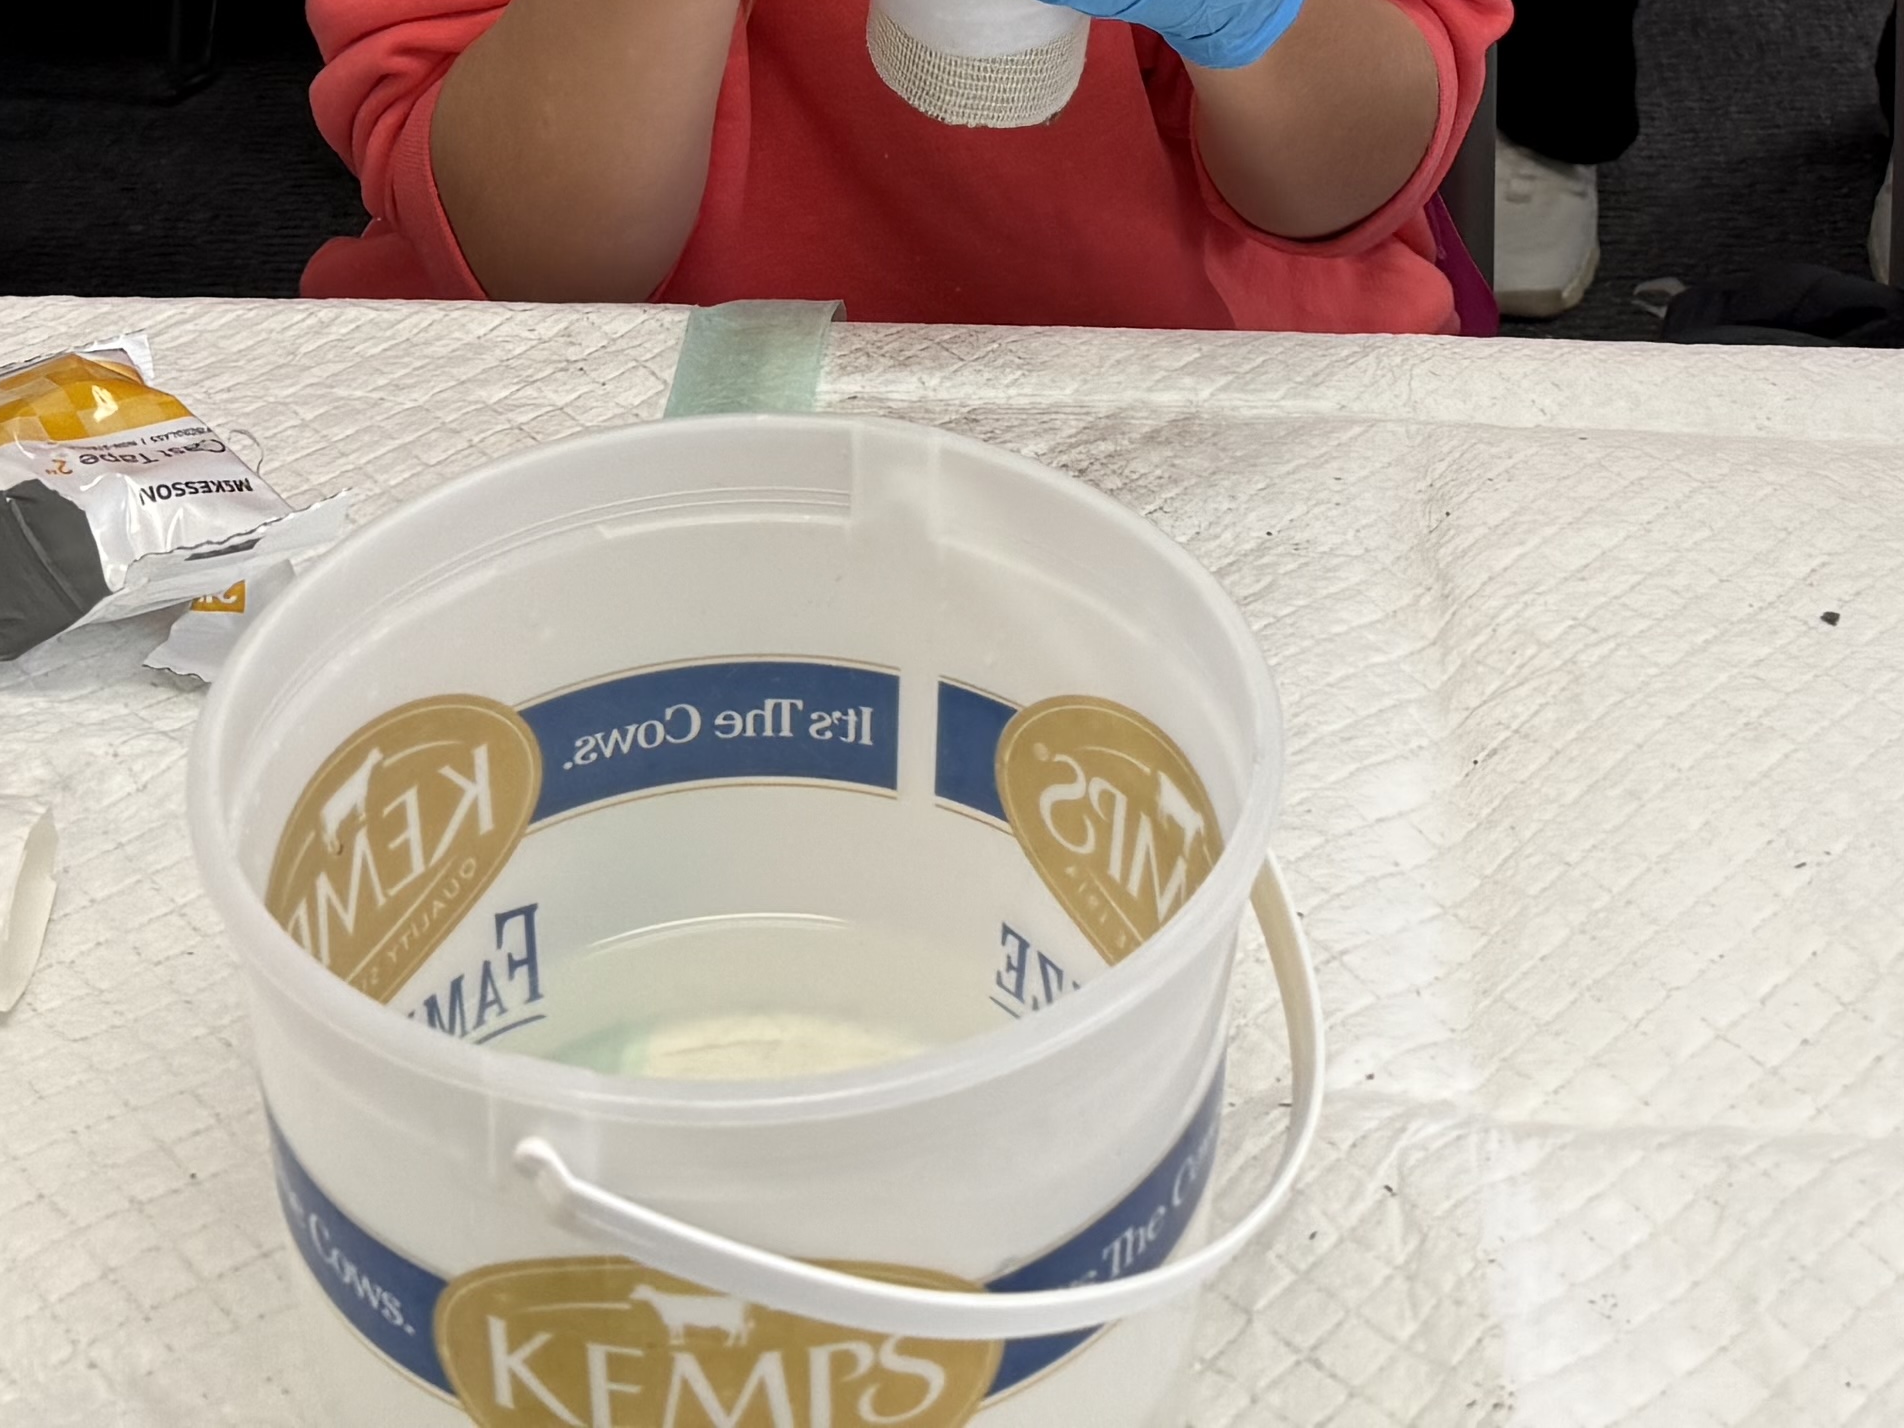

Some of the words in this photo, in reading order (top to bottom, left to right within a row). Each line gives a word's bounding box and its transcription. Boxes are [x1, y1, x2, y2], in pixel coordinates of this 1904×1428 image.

[79, 451, 159, 466] Tape
[161, 438, 227, 458] Cast
[308, 1212, 416, 1337] Cows.
[1102, 1204, 1167, 1279] The
[487, 1314, 948, 1428] KEMPS
